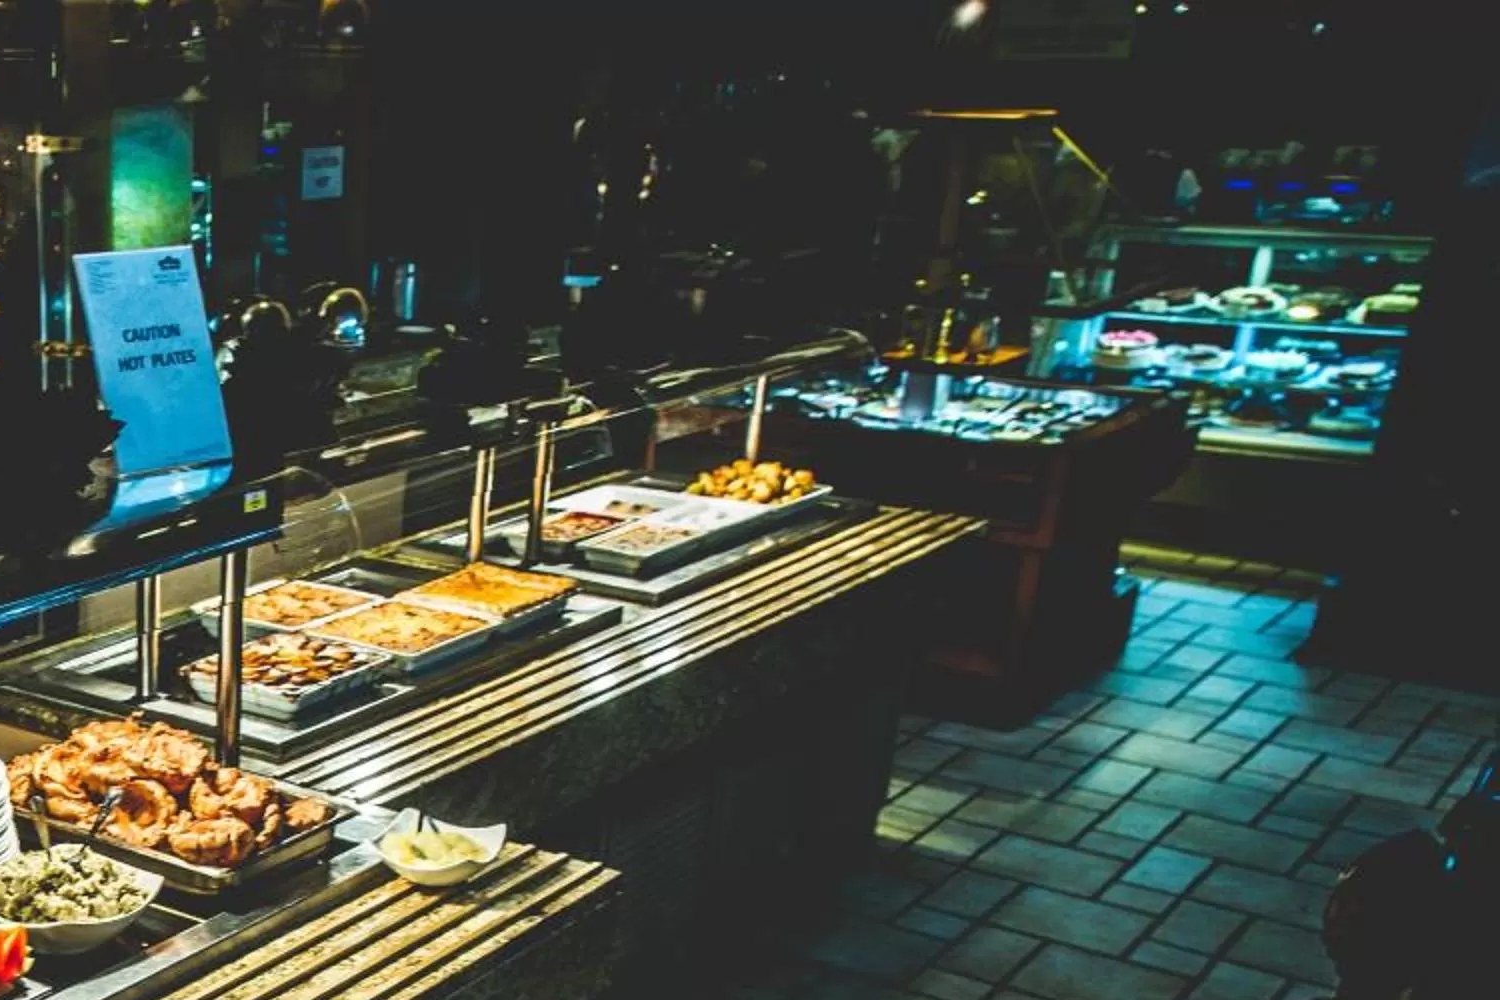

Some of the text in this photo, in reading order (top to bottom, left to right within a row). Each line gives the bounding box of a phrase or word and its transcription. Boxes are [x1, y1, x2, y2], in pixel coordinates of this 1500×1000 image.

[122, 324, 181, 342] CAUTION
[117, 349, 197, 373] HOT PLATES
